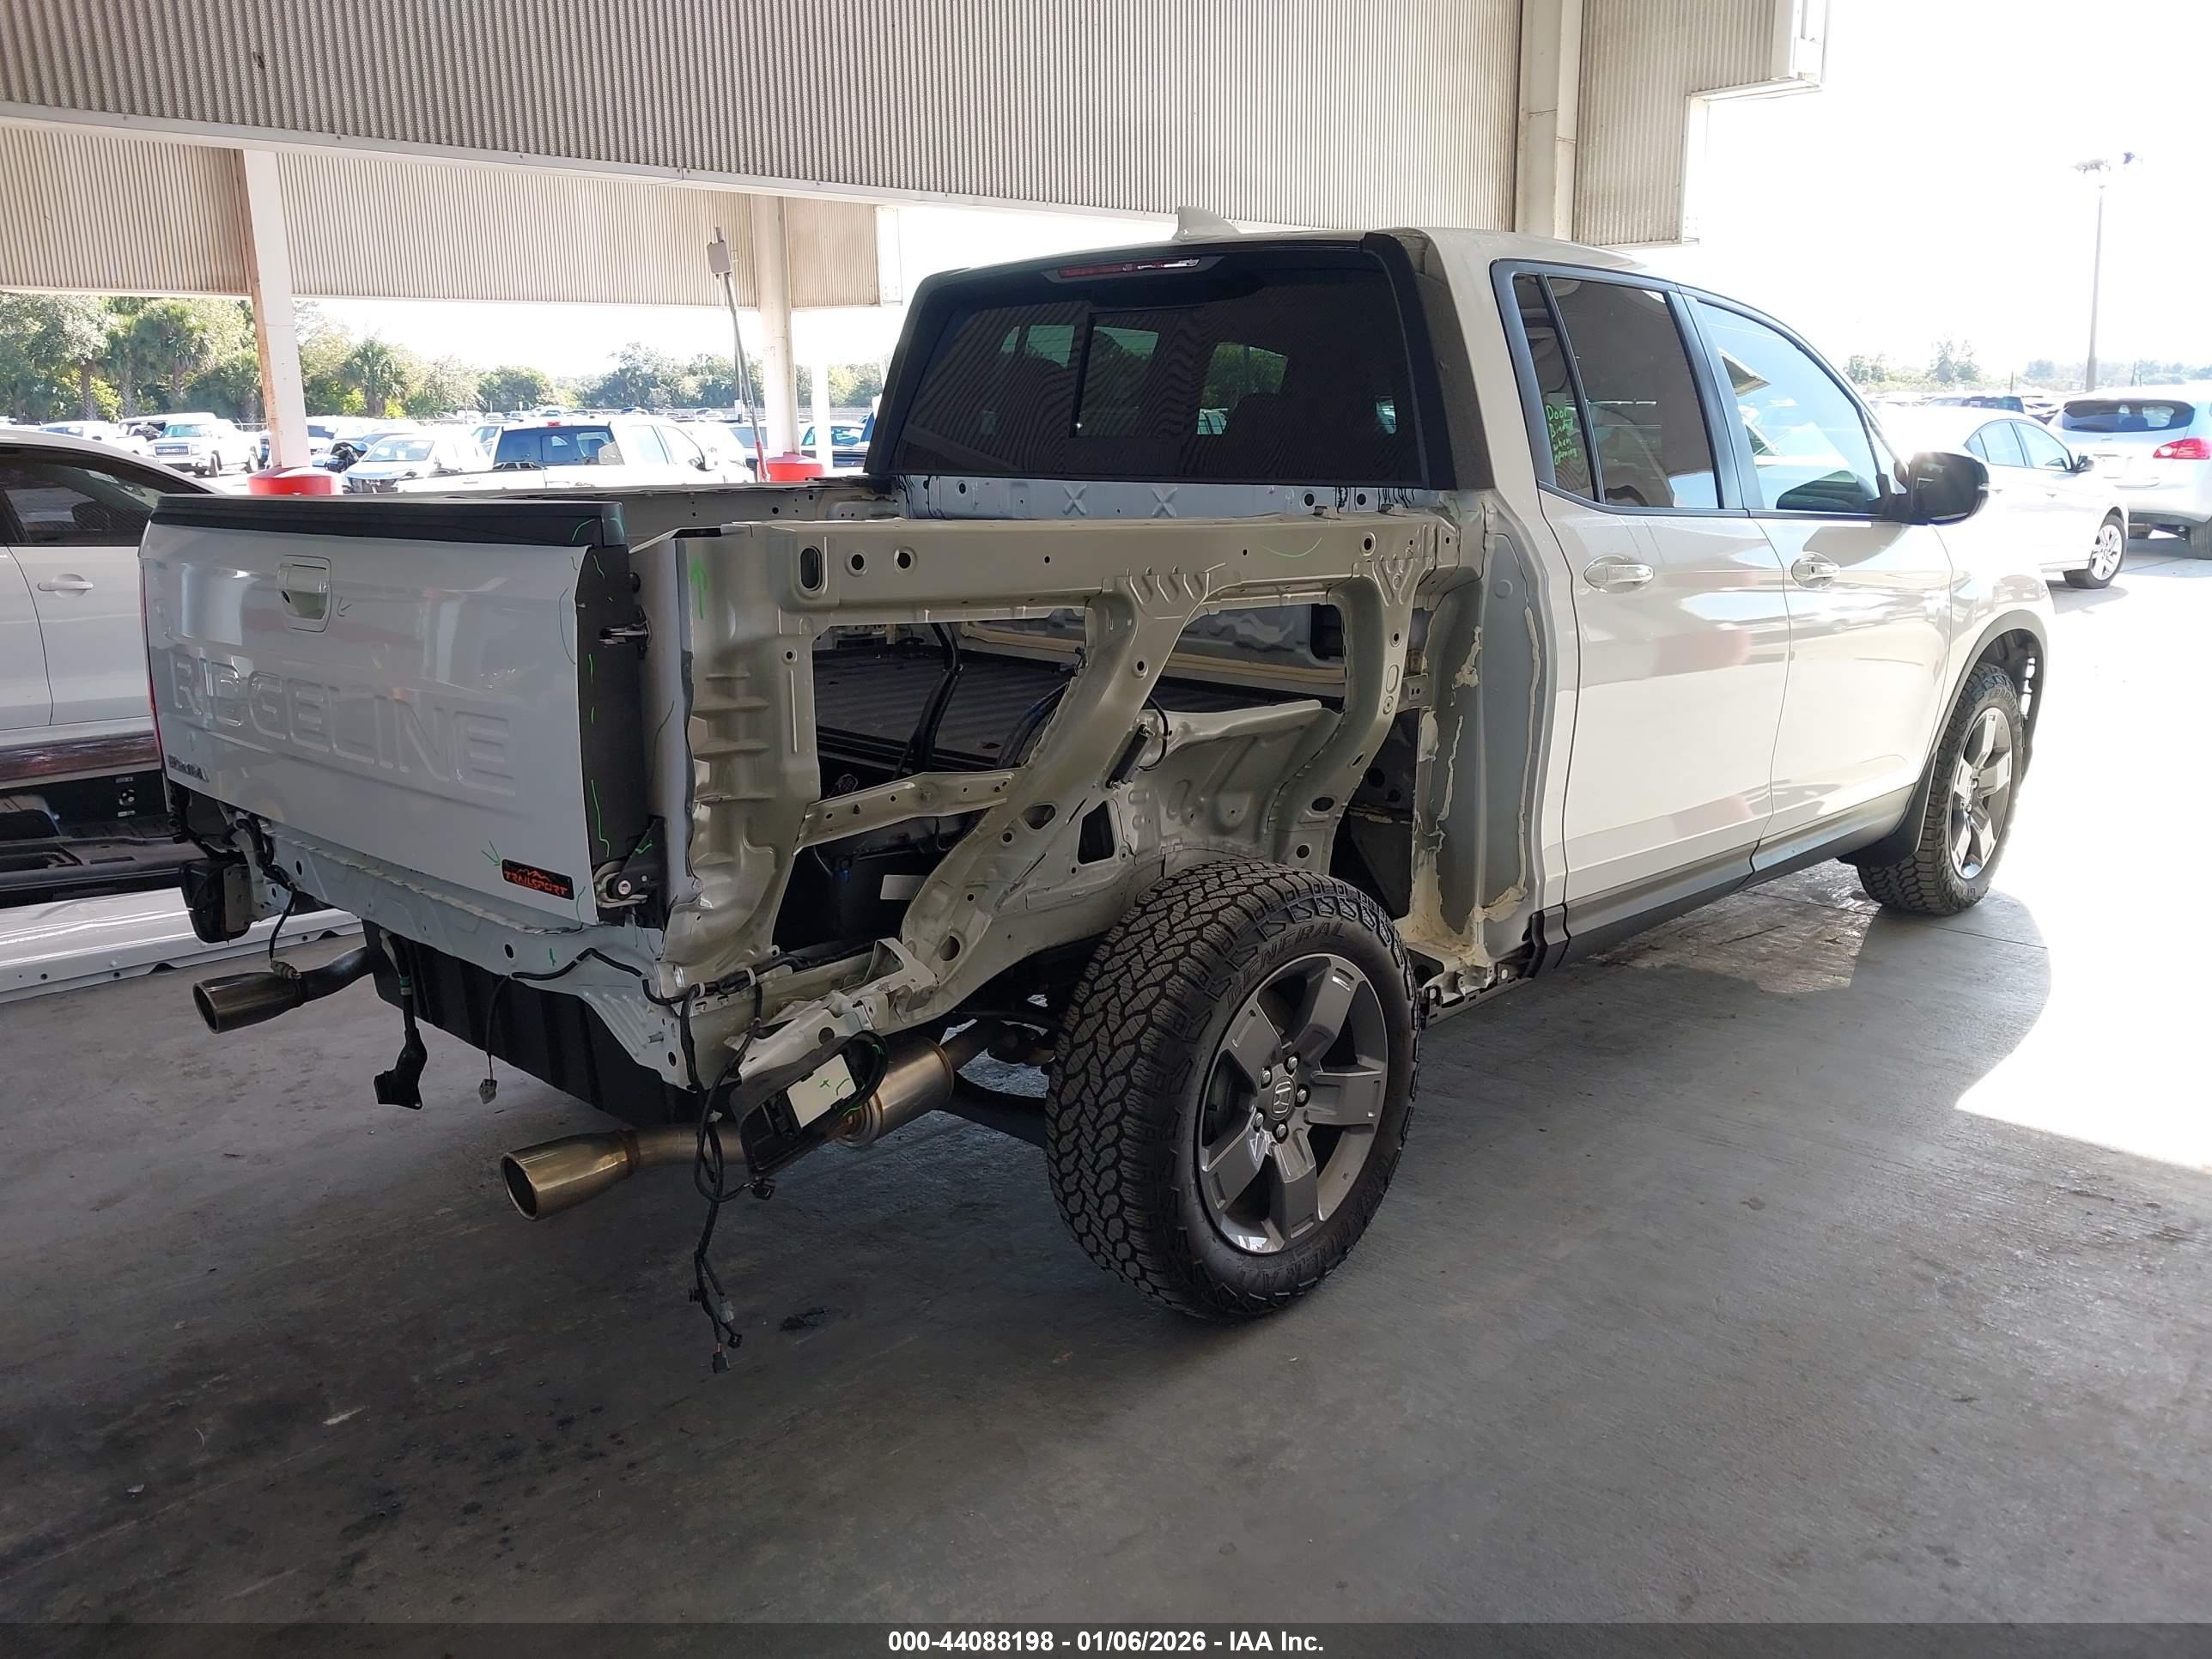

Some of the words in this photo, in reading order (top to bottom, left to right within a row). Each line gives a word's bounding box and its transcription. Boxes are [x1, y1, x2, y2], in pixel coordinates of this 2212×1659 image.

[1546, 405, 1568, 421] Door
[173, 649, 515, 797] RIDGELINE
[504, 871, 568, 895] TRAILSPORT
[1227, 921, 1346, 1010] GENERAL
